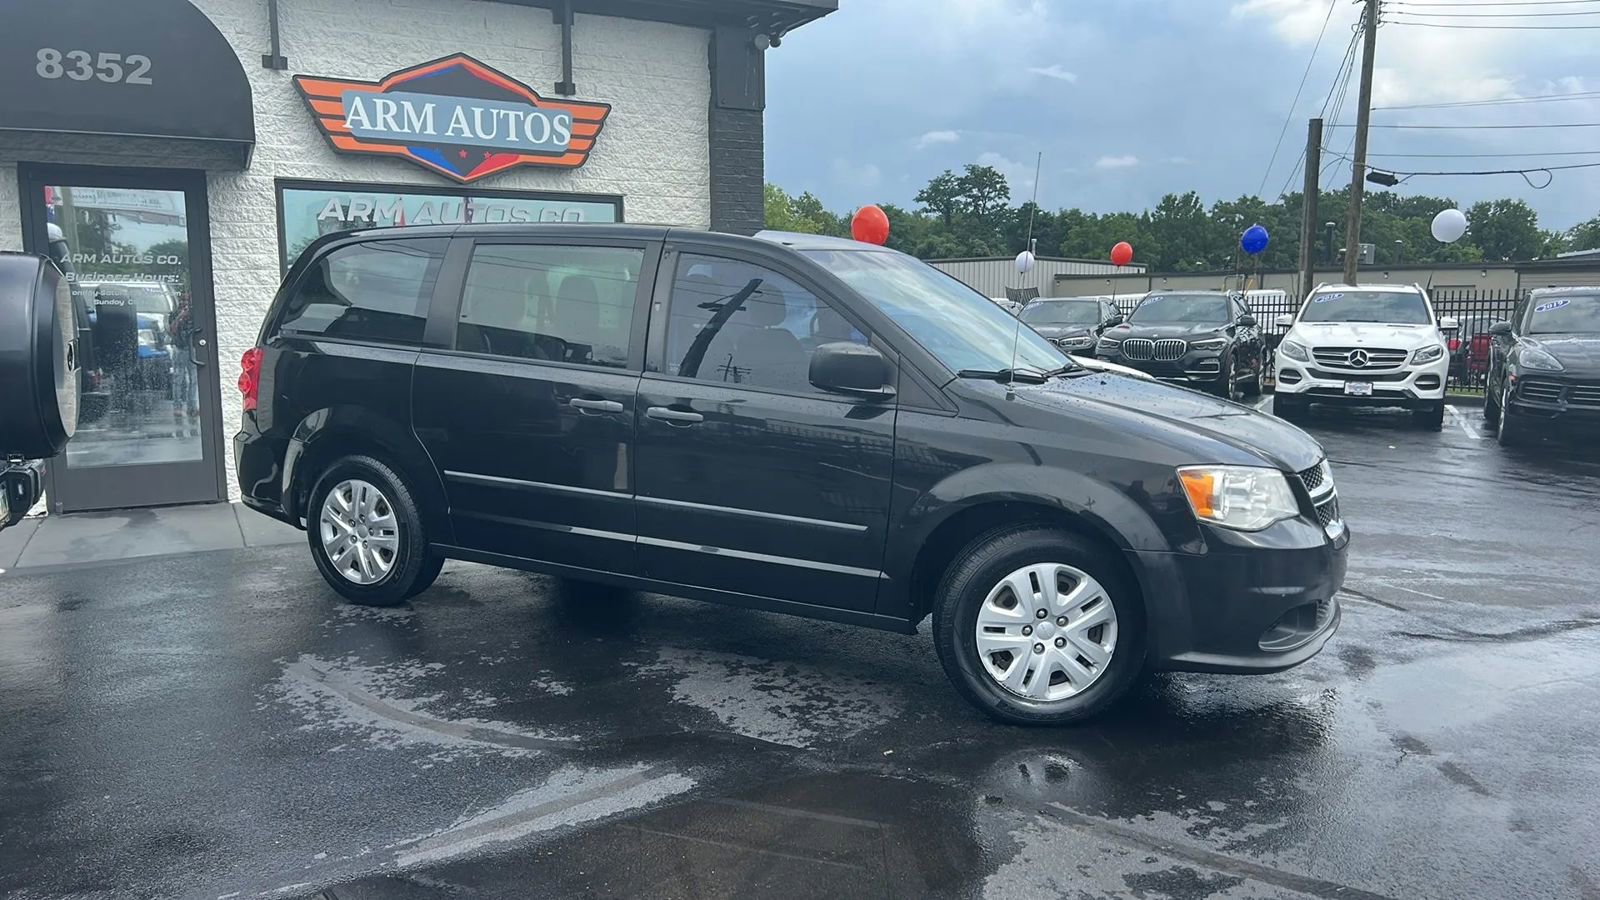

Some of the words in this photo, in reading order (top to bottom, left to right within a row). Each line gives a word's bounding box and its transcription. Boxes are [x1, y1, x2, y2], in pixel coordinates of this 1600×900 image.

[36, 47, 153, 85] 8352
[343, 96, 437, 135] ARM
[445, 105, 572, 146] AUTOS
[317, 197, 402, 226] ARM
[411, 200, 532, 224] AUTOS
[60, 252, 97, 264] ARM
[100, 253, 154, 265] AUTOS
[156, 255, 182, 265] CO.
[65, 271, 131, 282] Business
